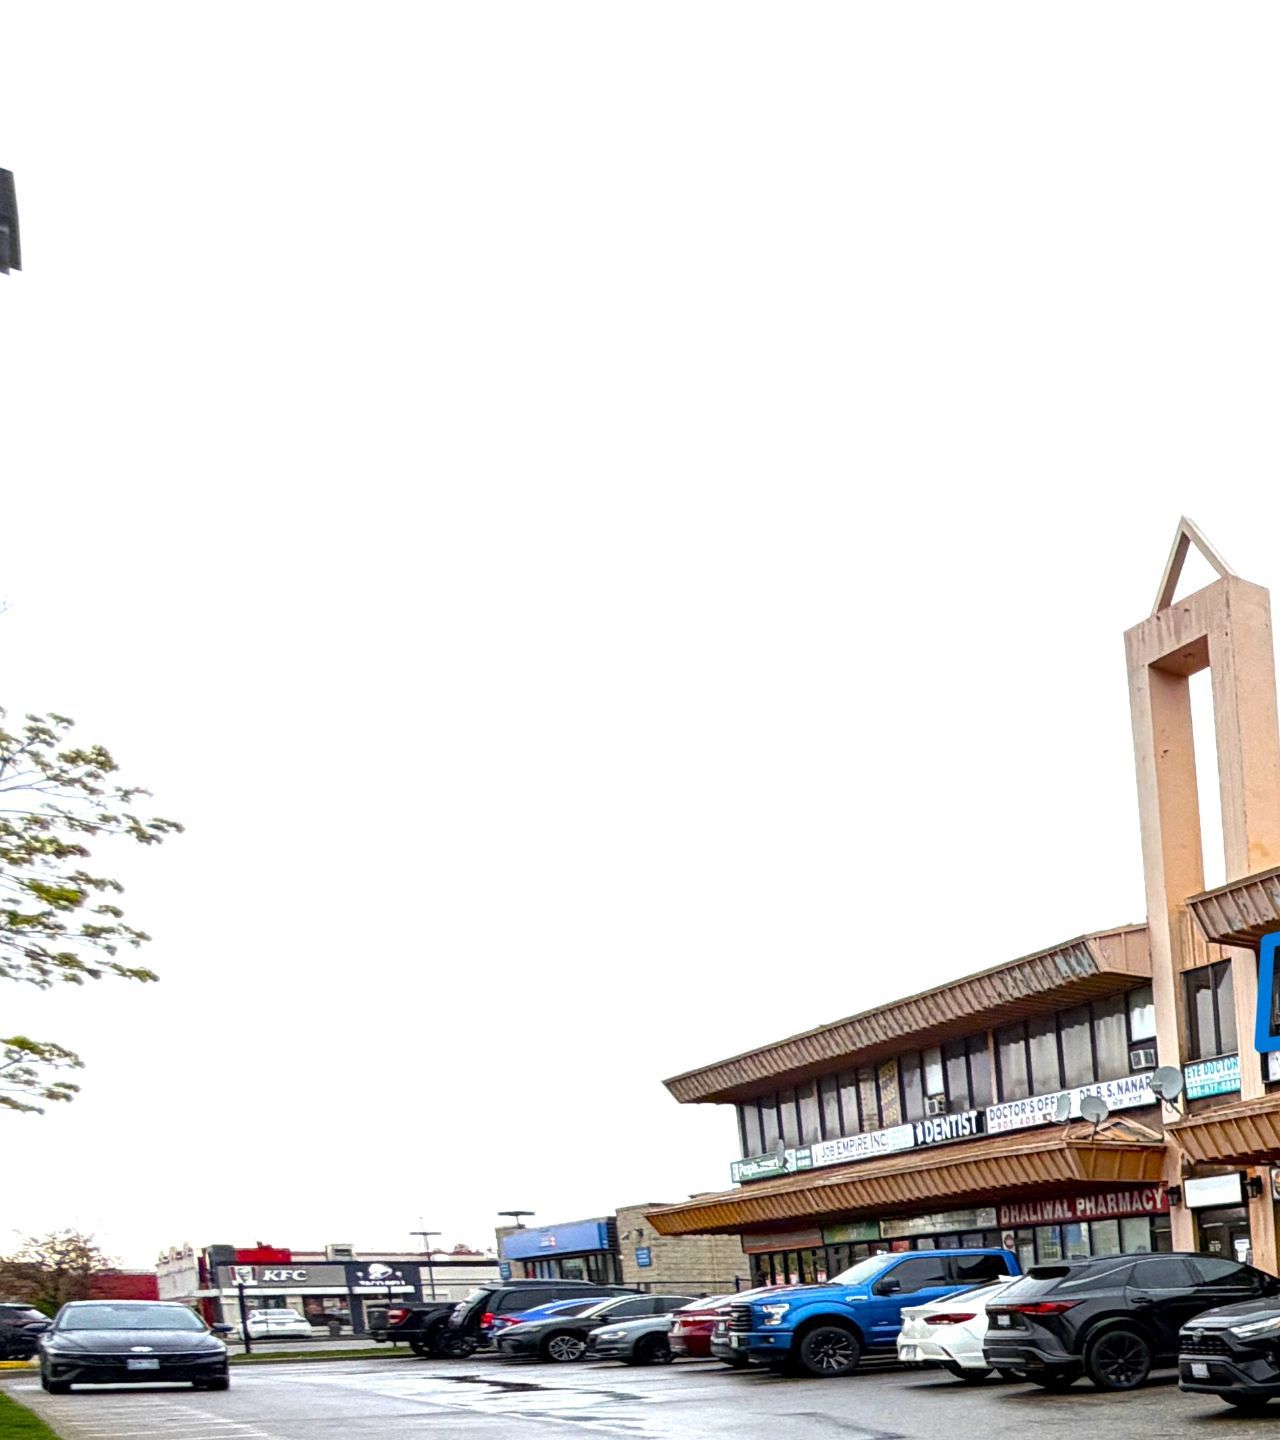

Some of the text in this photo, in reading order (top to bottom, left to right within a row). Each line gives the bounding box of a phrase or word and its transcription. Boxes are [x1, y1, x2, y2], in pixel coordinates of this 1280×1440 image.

[1187, 1064, 1201, 1079] EYE
[1203, 1056, 1239, 1075] DOCTOR
[989, 1102, 1035, 1121] DOCTOR'S
[925, 1110, 977, 1144] DENTIST
[821, 1146, 835, 1158] JOB
[837, 1136, 868, 1155] EMPIRE
[1000, 1187, 1164, 1224] DHALIWAL PHARMACY
[262, 1269, 308, 1281] KFC
